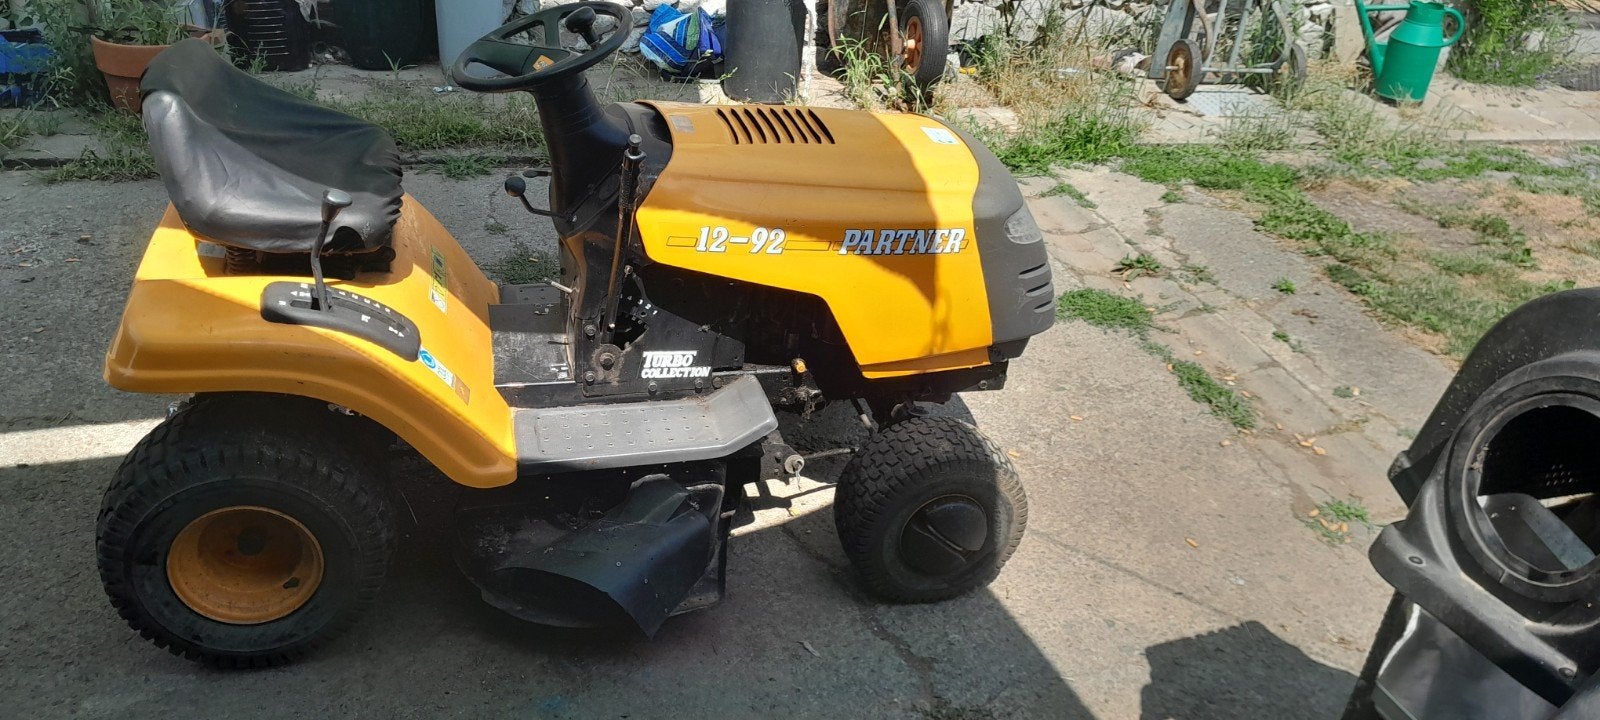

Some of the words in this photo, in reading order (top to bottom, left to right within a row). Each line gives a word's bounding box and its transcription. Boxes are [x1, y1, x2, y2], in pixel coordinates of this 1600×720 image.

[696, 226, 786, 254] 12-92
[838, 228, 967, 255] PARTNER
[643, 351, 697, 368] TURBO
[641, 367, 711, 379] COLLECTION
